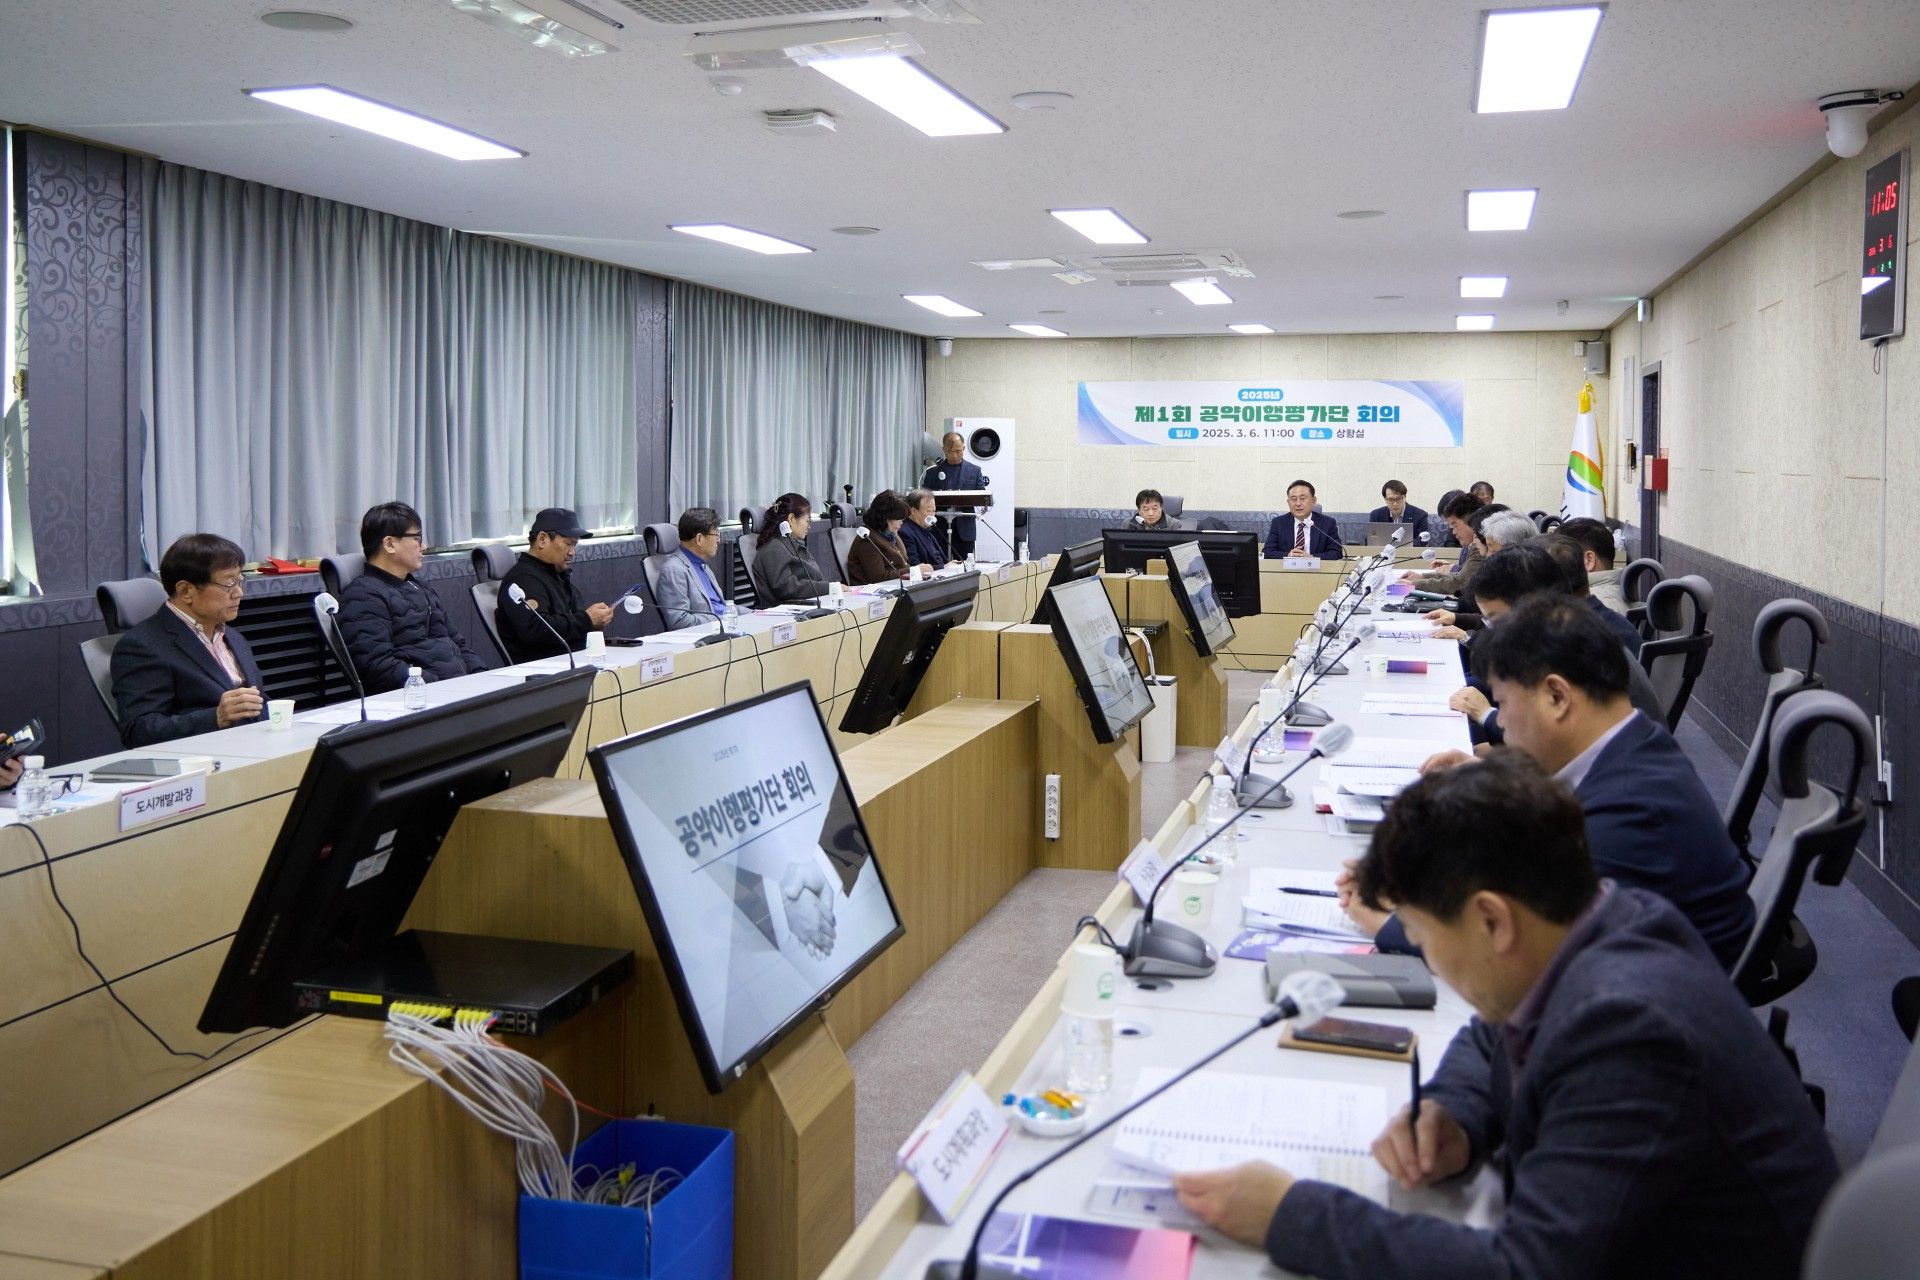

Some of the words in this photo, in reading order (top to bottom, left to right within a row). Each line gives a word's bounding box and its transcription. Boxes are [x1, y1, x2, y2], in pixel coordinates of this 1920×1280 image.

[1872, 181, 1897, 216] 11:05
[1241, 390, 1281, 400] 2025년
[1135, 404, 1192, 423] 제1회
[1199, 405, 1350, 423] 공약이행평가단
[1356, 404, 1400, 423] 회의
[1202, 428, 1234, 438] 2025.
[1236, 428, 1247, 438] 3.
[1249, 428, 1260, 438] 6.
[1264, 428, 1295, 438] 11:00
[1336, 428, 1365, 439] 상황실
[136, 787, 193, 814] 도시개발과장
[675, 773, 788, 858] 공약이행평가단
[781, 760, 816, 802] 회의
